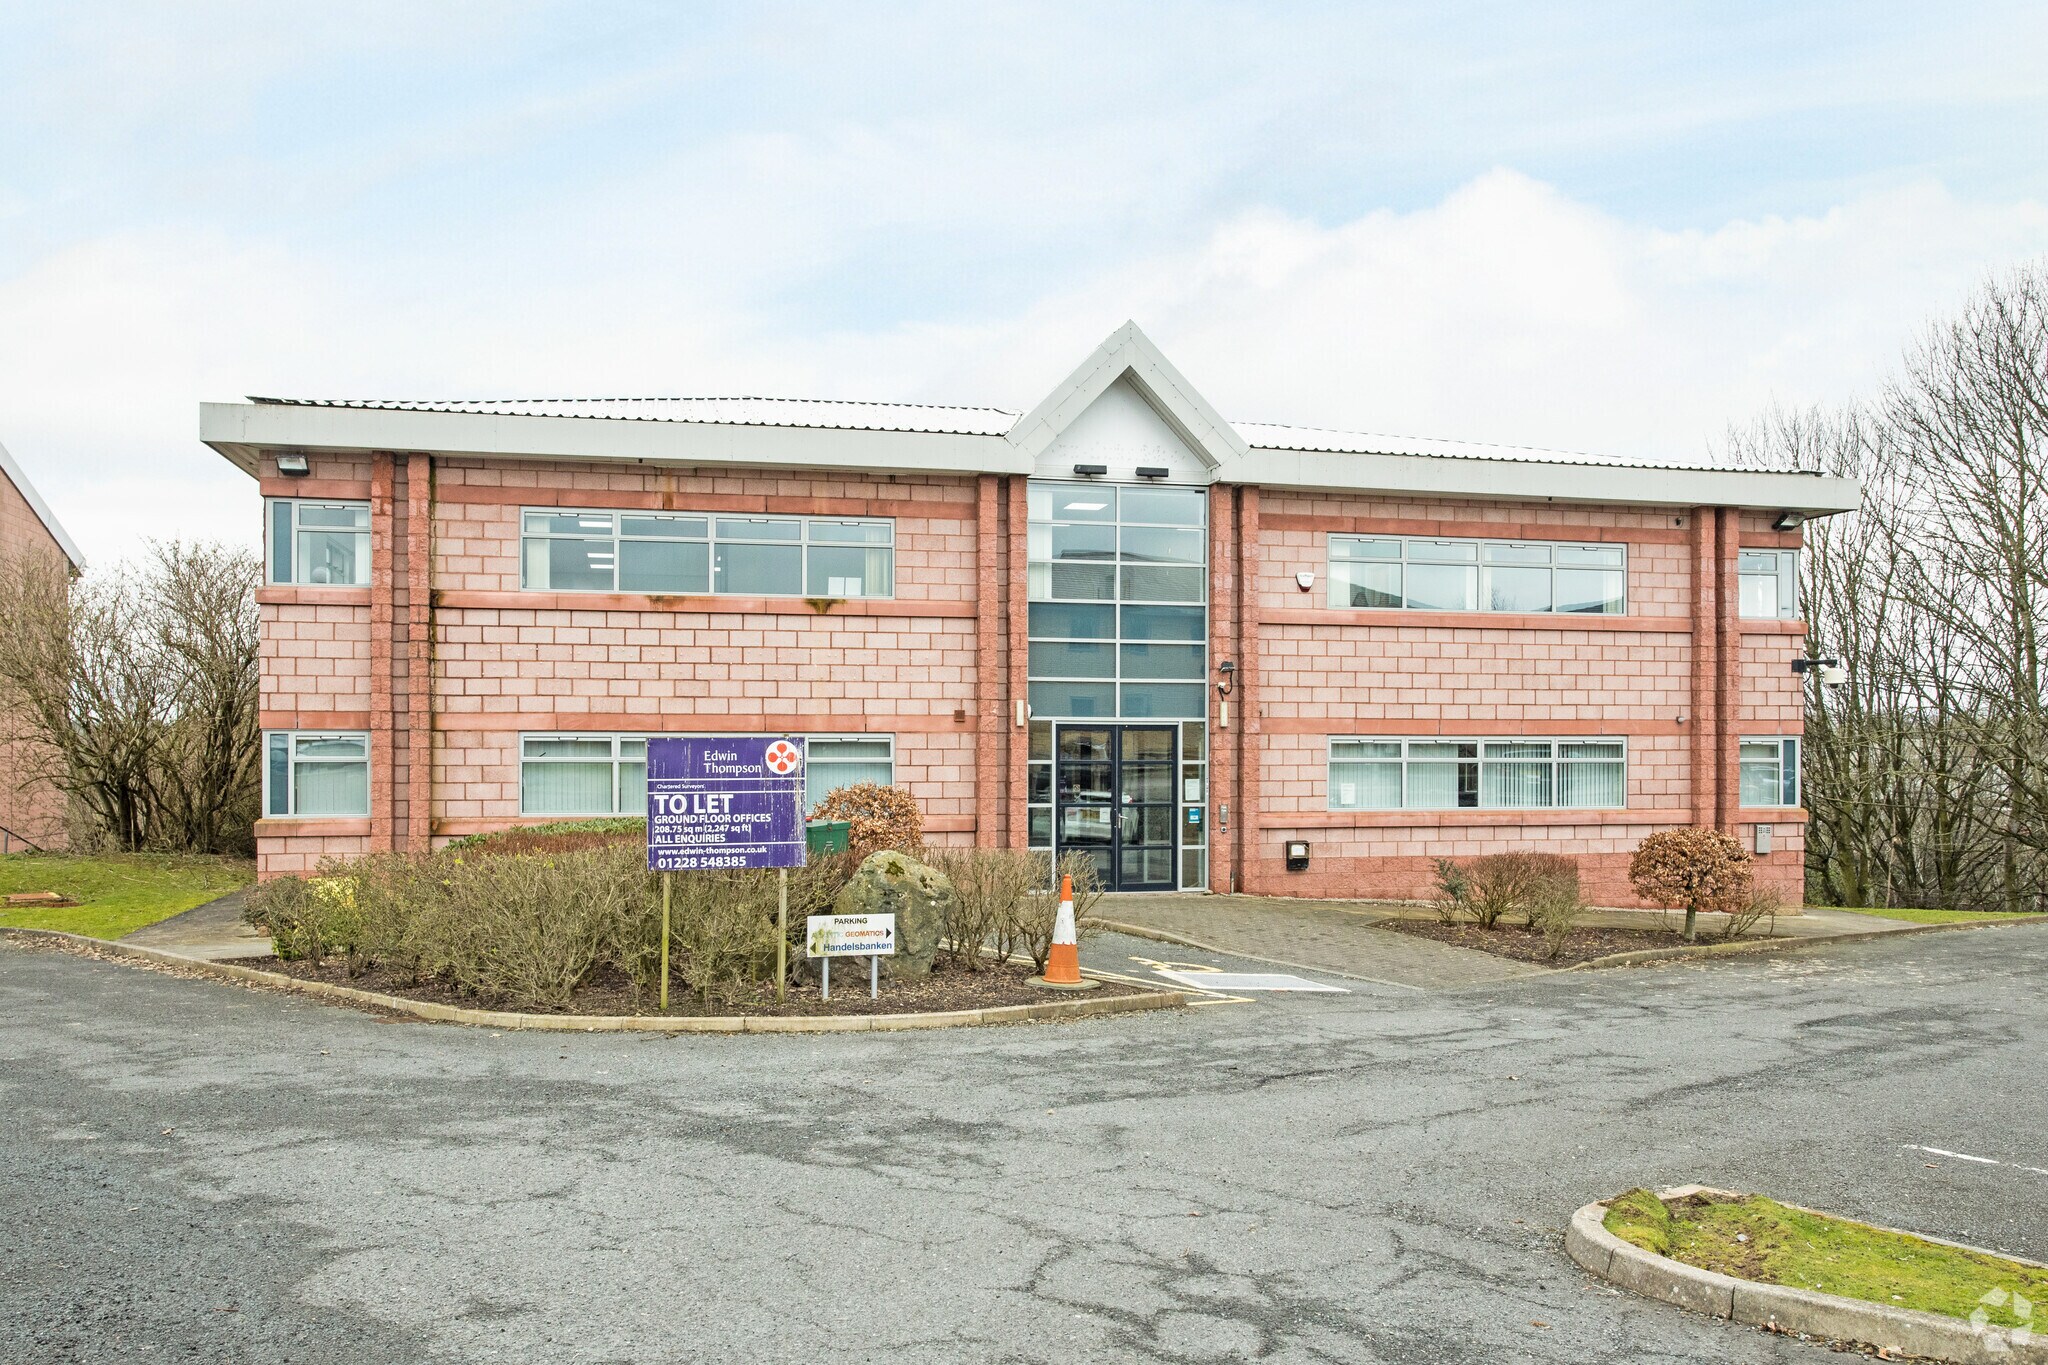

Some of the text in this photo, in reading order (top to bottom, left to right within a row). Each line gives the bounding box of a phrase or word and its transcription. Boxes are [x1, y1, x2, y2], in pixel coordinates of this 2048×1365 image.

[704, 750, 737, 761] Edwin
[704, 763, 762, 776] Thompson
[654, 794, 734, 814] TO LET
[655, 813, 771, 824] GROUND FLOOR OFFICES
[655, 825, 682, 833] 208.75
[683, 826, 693, 835] sq
[704, 824, 729, 834] (2,247
[731, 825, 741, 834] sq
[741, 824, 752, 833] ft)
[655, 834, 726, 844] ALL ENQUIRIES
[658, 846, 767, 856] www.edwin-thompson.co.uk
[658, 856, 747, 868] 01228 548385
[834, 917, 868, 925] PARKING
[845, 930, 884, 938] GEOMATICS
[823, 942, 893, 952] Handelsbanken
